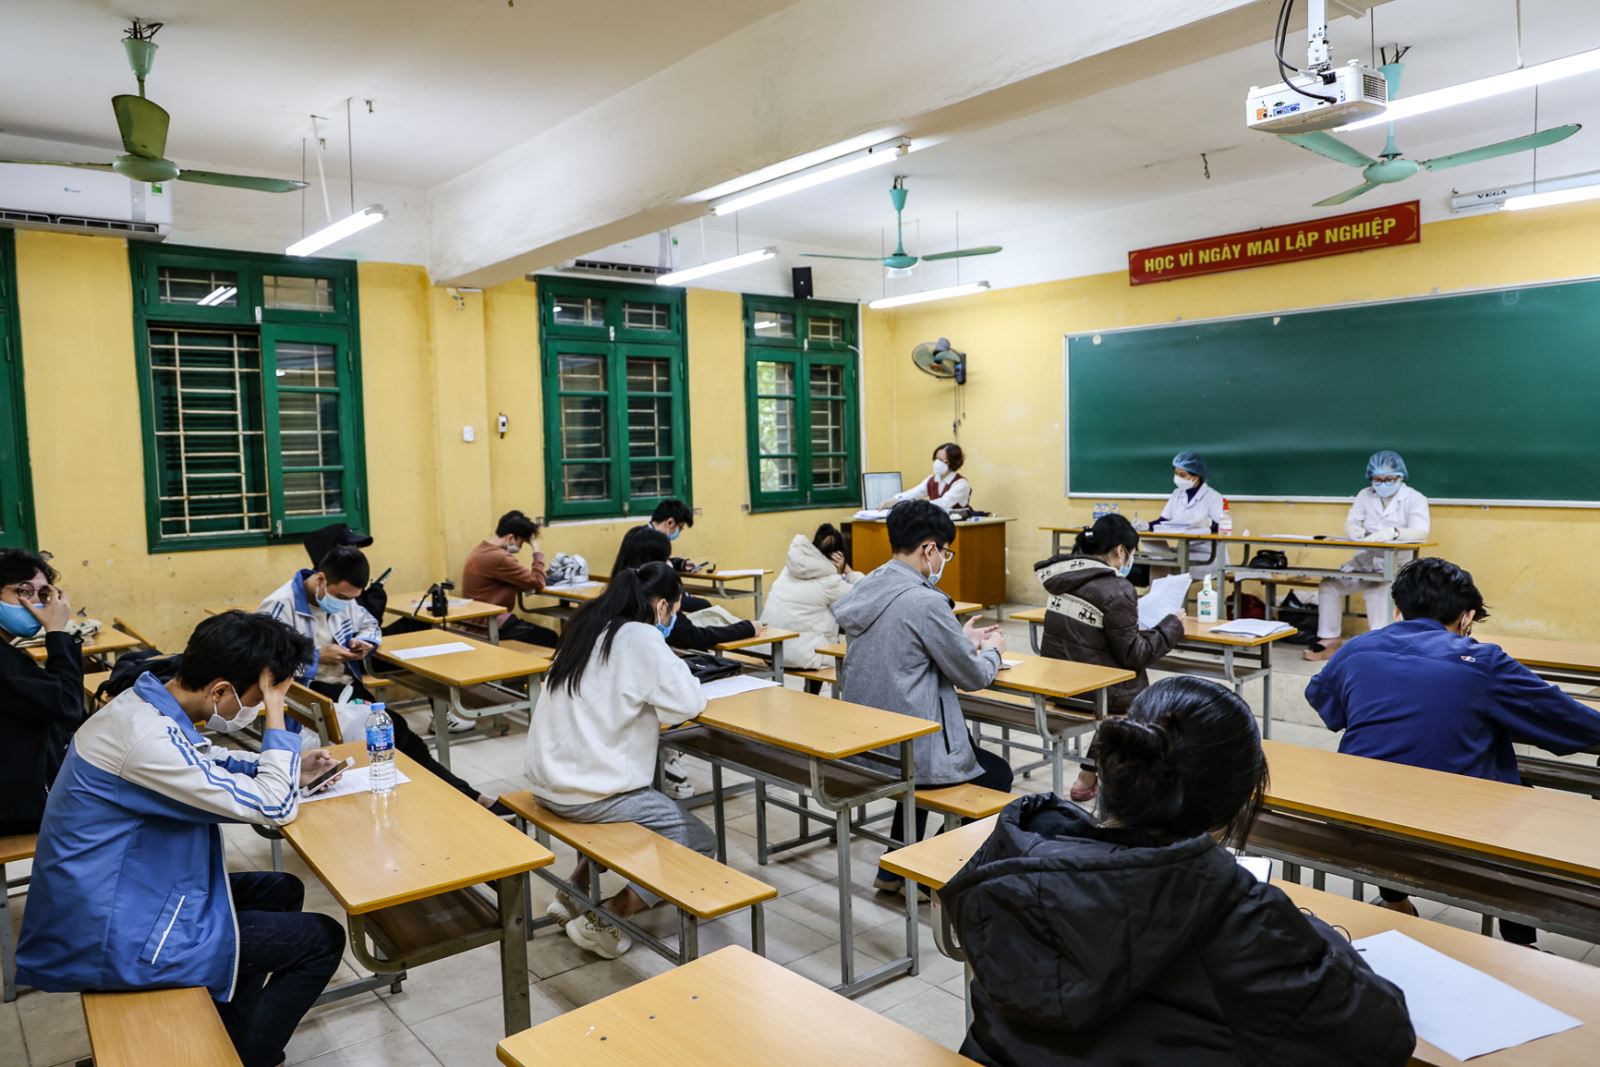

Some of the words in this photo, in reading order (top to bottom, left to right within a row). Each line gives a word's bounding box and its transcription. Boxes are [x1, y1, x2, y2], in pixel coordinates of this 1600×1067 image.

[1477, 189, 1507, 199] VEGA
[1144, 254, 1175, 274] HỌC
[1179, 248, 1194, 267] VÌ
[1198, 243, 1242, 264] NGÀY
[1247, 237, 1280, 257] MAI
[1285, 230, 1319, 252] LẬP
[1325, 217, 1397, 244] NGHIỆP
